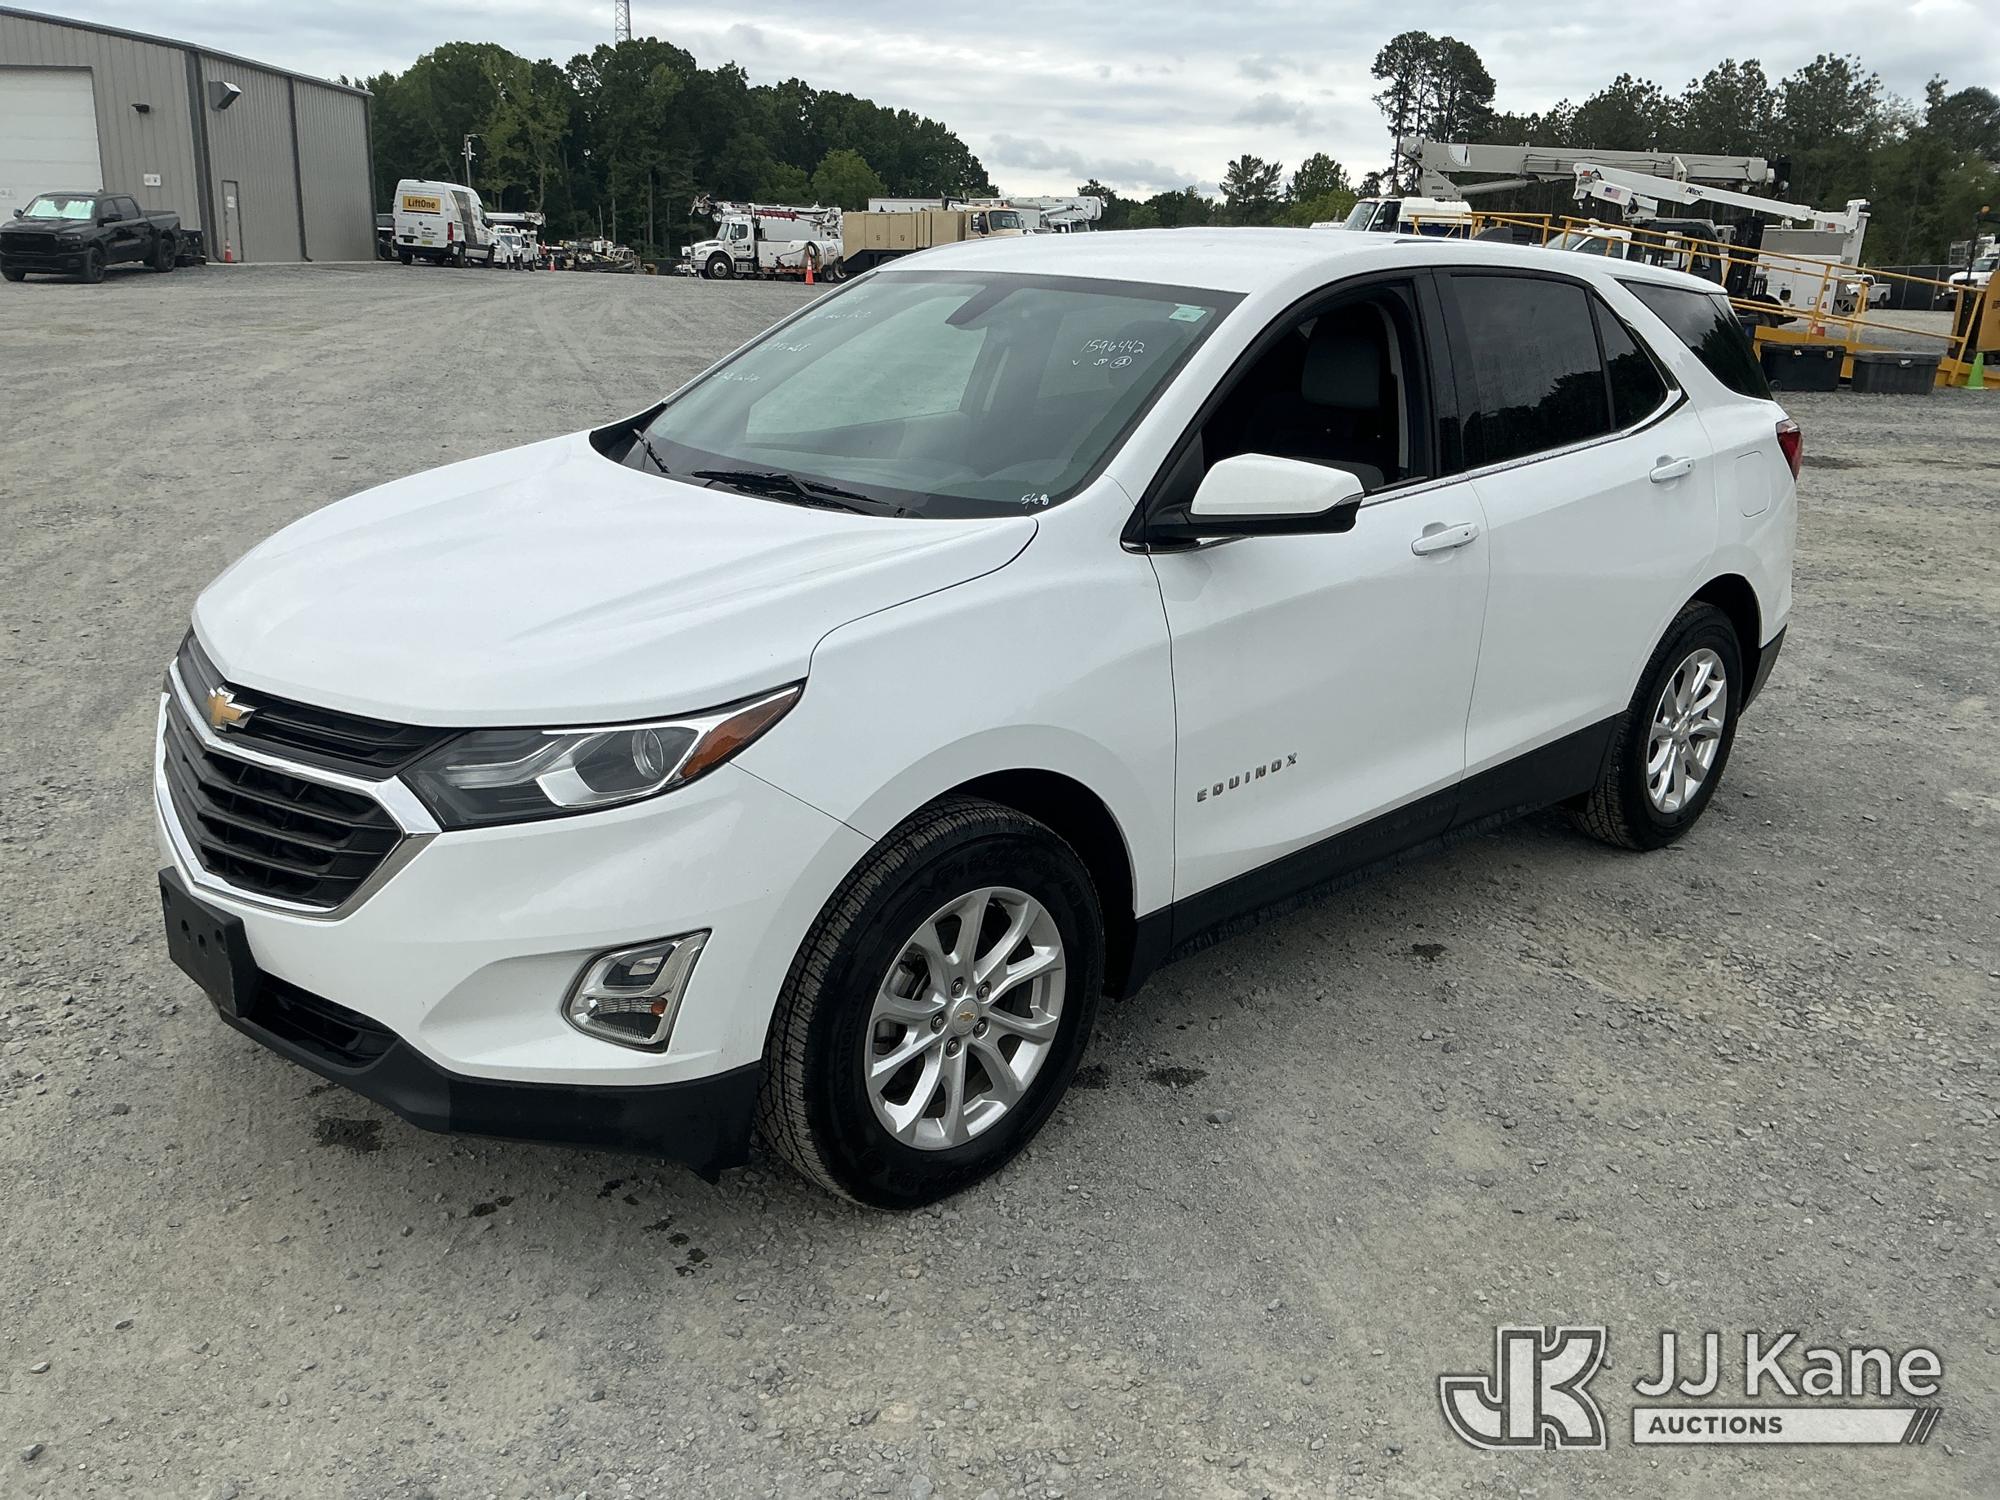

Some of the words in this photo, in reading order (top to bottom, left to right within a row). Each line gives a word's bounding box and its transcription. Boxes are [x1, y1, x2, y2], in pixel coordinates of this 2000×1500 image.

[408, 199, 436, 208] LiftOne
[1080, 340, 1144, 354] 1596442
[1196, 752, 1298, 803] EQUINOX
